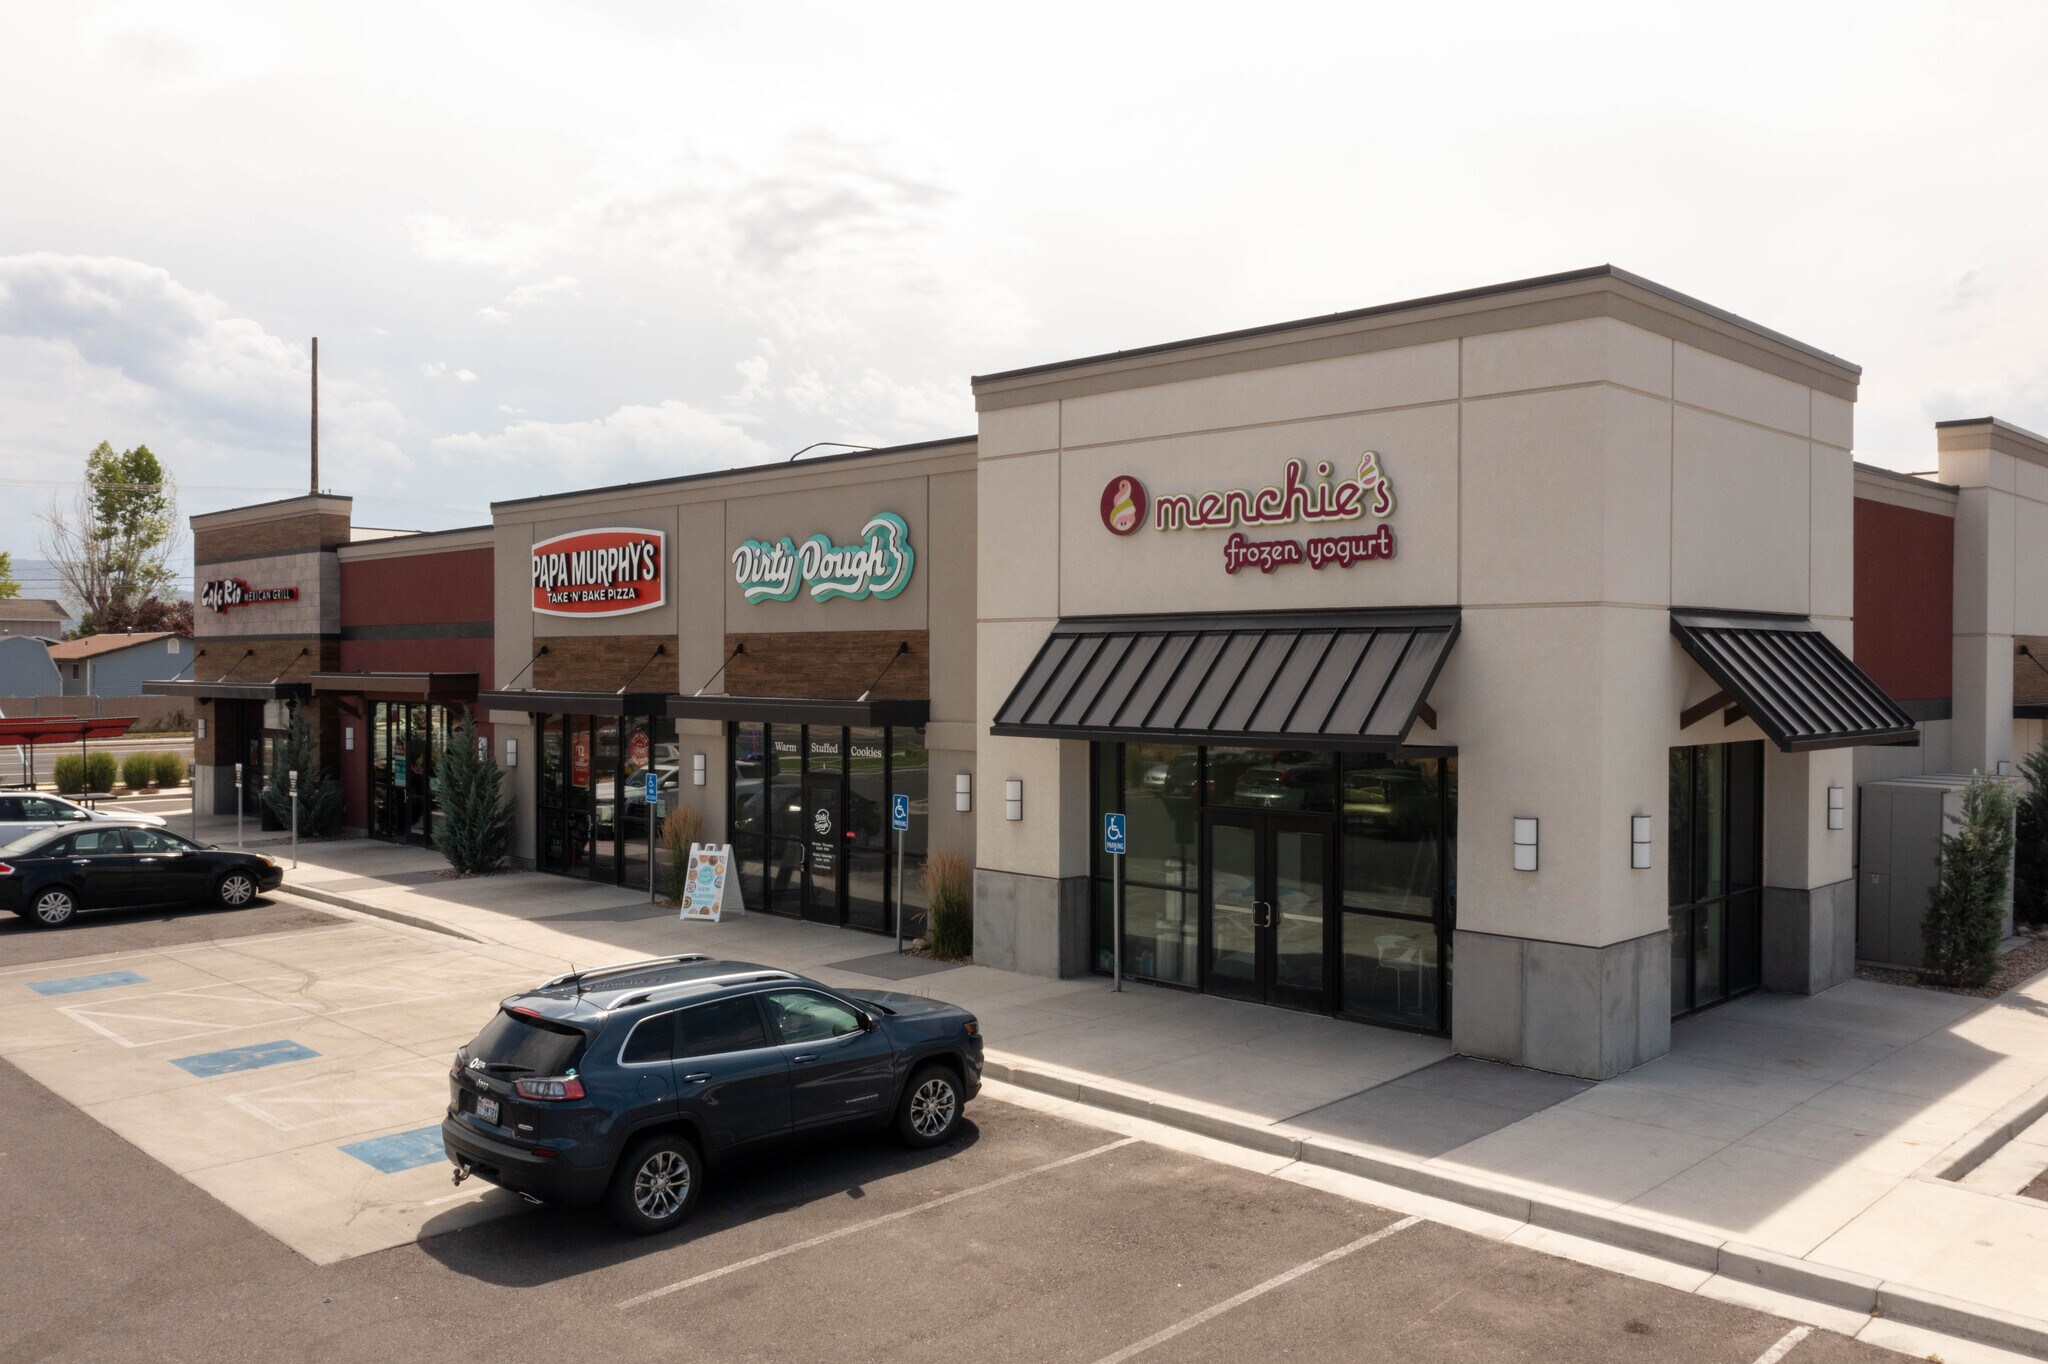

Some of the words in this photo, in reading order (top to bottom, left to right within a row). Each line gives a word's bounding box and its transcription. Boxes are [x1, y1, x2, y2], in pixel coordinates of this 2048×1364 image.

[1155, 450, 1396, 530] menchie's
[1226, 537, 1301, 570] frozen
[1309, 528, 1391, 567] yogurt
[532, 552, 569, 592] PAPA
[571, 539, 655, 587] MURPHY'S
[732, 543, 795, 598] Dirty
[799, 533, 889, 597] Dough
[243, 590, 271, 602] MEXICAN
[272, 589, 290, 600] GRILL
[547, 592, 569, 604] TAKE
[582, 589, 606, 602] BAKE
[607, 587, 636, 600] PIZZA
[775, 741, 797, 753] Warm
[811, 742, 839, 754] Stuffed
[850, 745, 883, 758] Cookies
[1106, 841, 1124, 850] PARKING
